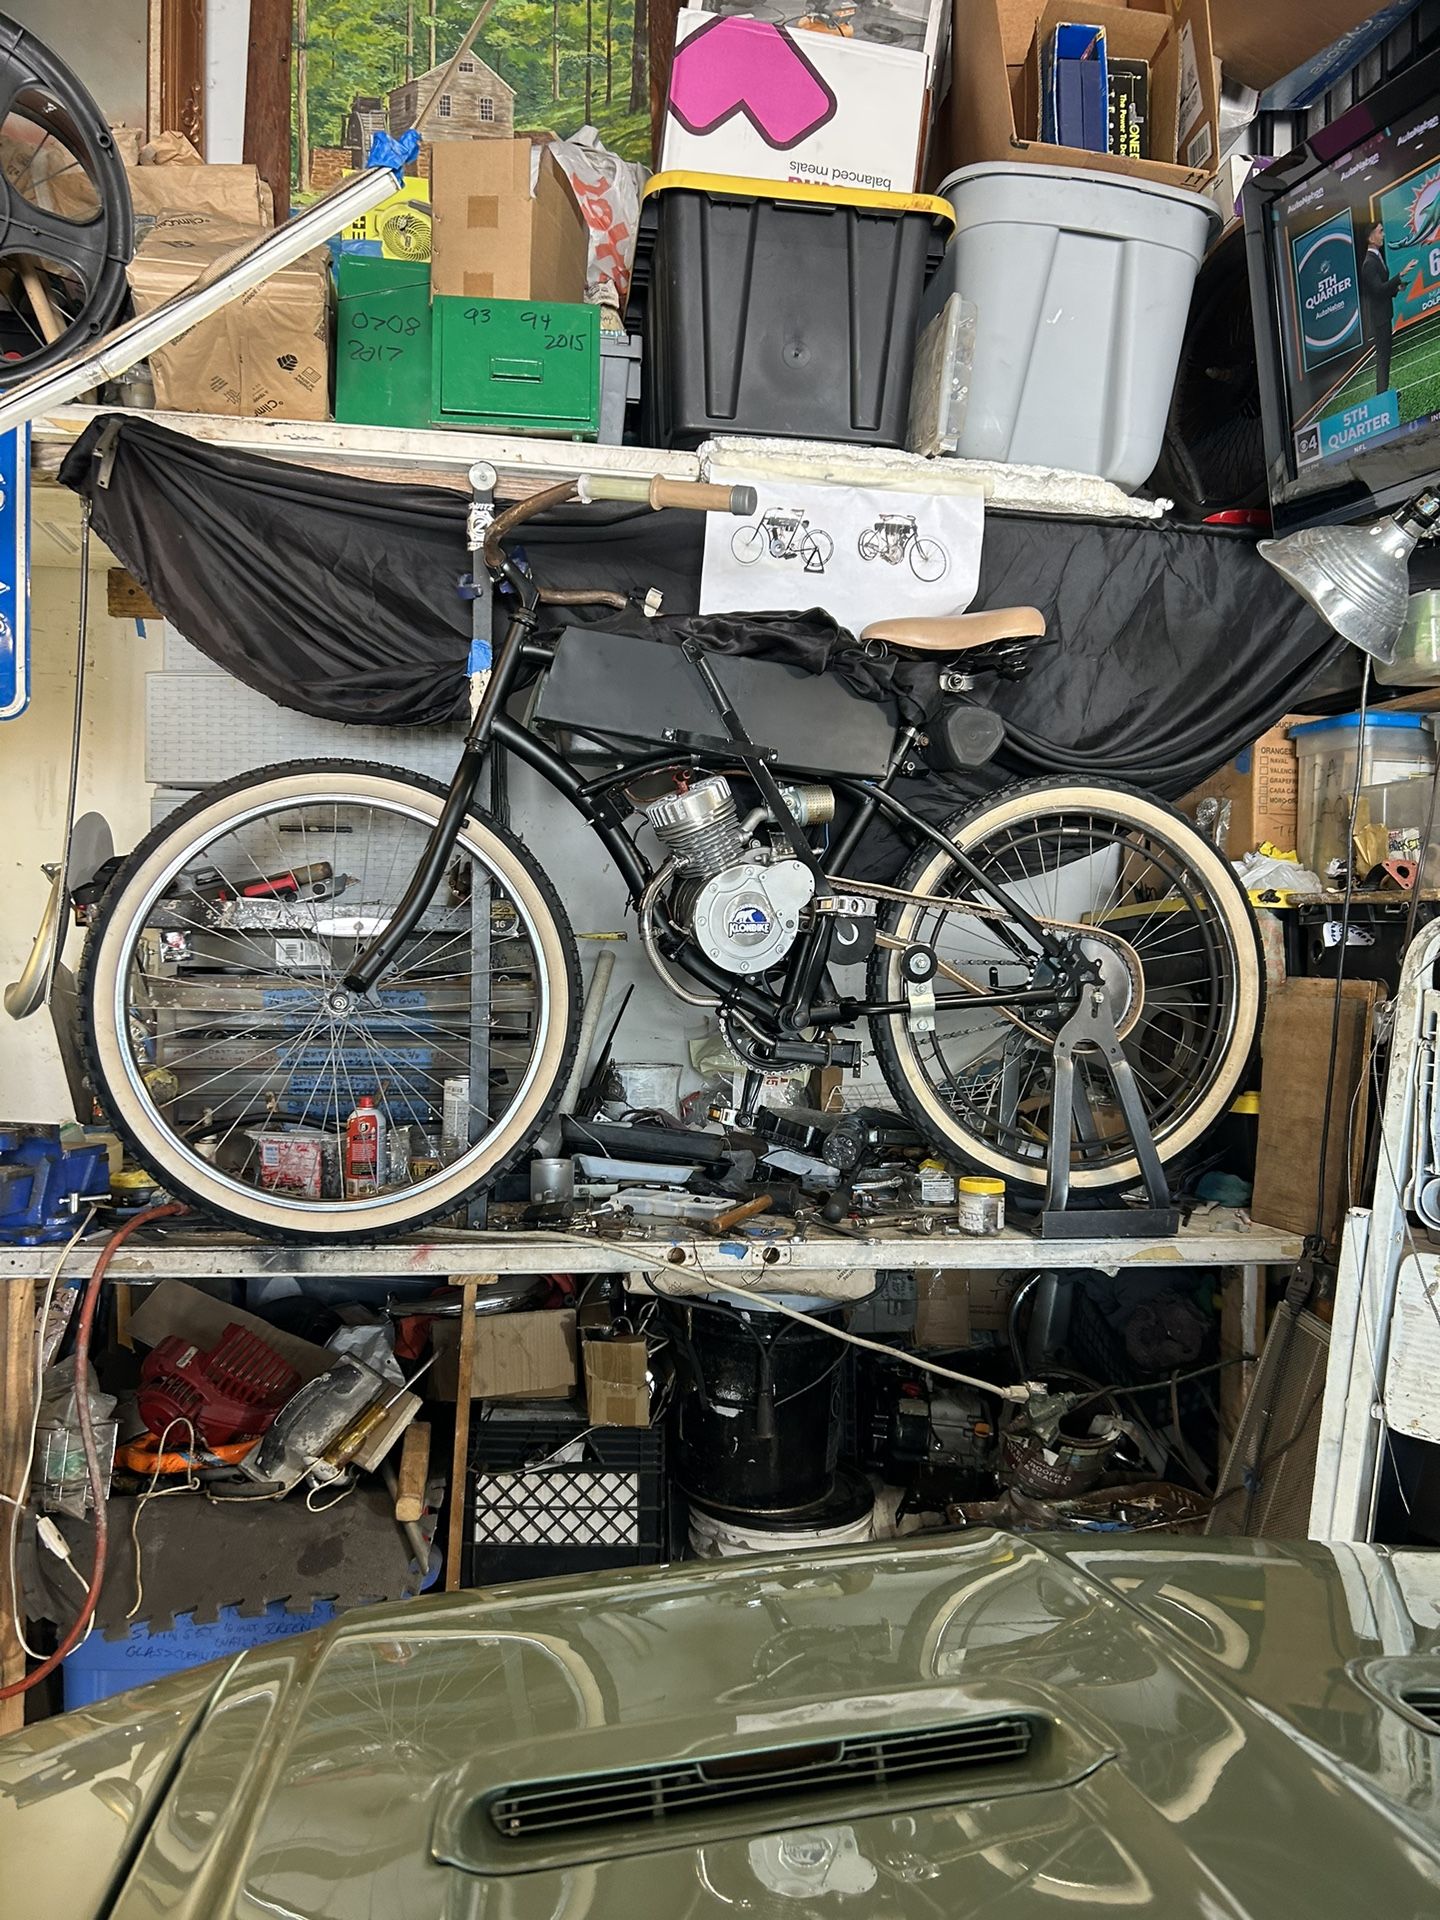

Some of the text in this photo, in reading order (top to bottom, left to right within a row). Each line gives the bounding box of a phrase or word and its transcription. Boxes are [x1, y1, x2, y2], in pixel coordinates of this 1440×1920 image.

[1119, 93, 1128, 108] The
[1119, 109, 1128, 131] Power
[1119, 133, 1127, 142] To
[789, 160, 829, 176] meals
[831, 168, 892, 191] balanced
[1317, 273, 1337, 293] 5TH
[1305, 277, 1351, 310] QUARTER
[1315, 300, 1345, 320] AutoNation
[544, 333, 587, 351] 2015
[1343, 405, 1368, 427] 5TH
[1328, 412, 1391, 449] QUARTER
[1353, 443, 1367, 454] NFL
[1260, 746, 1293, 756] ORANGES
[494, 920, 506, 928] 16
